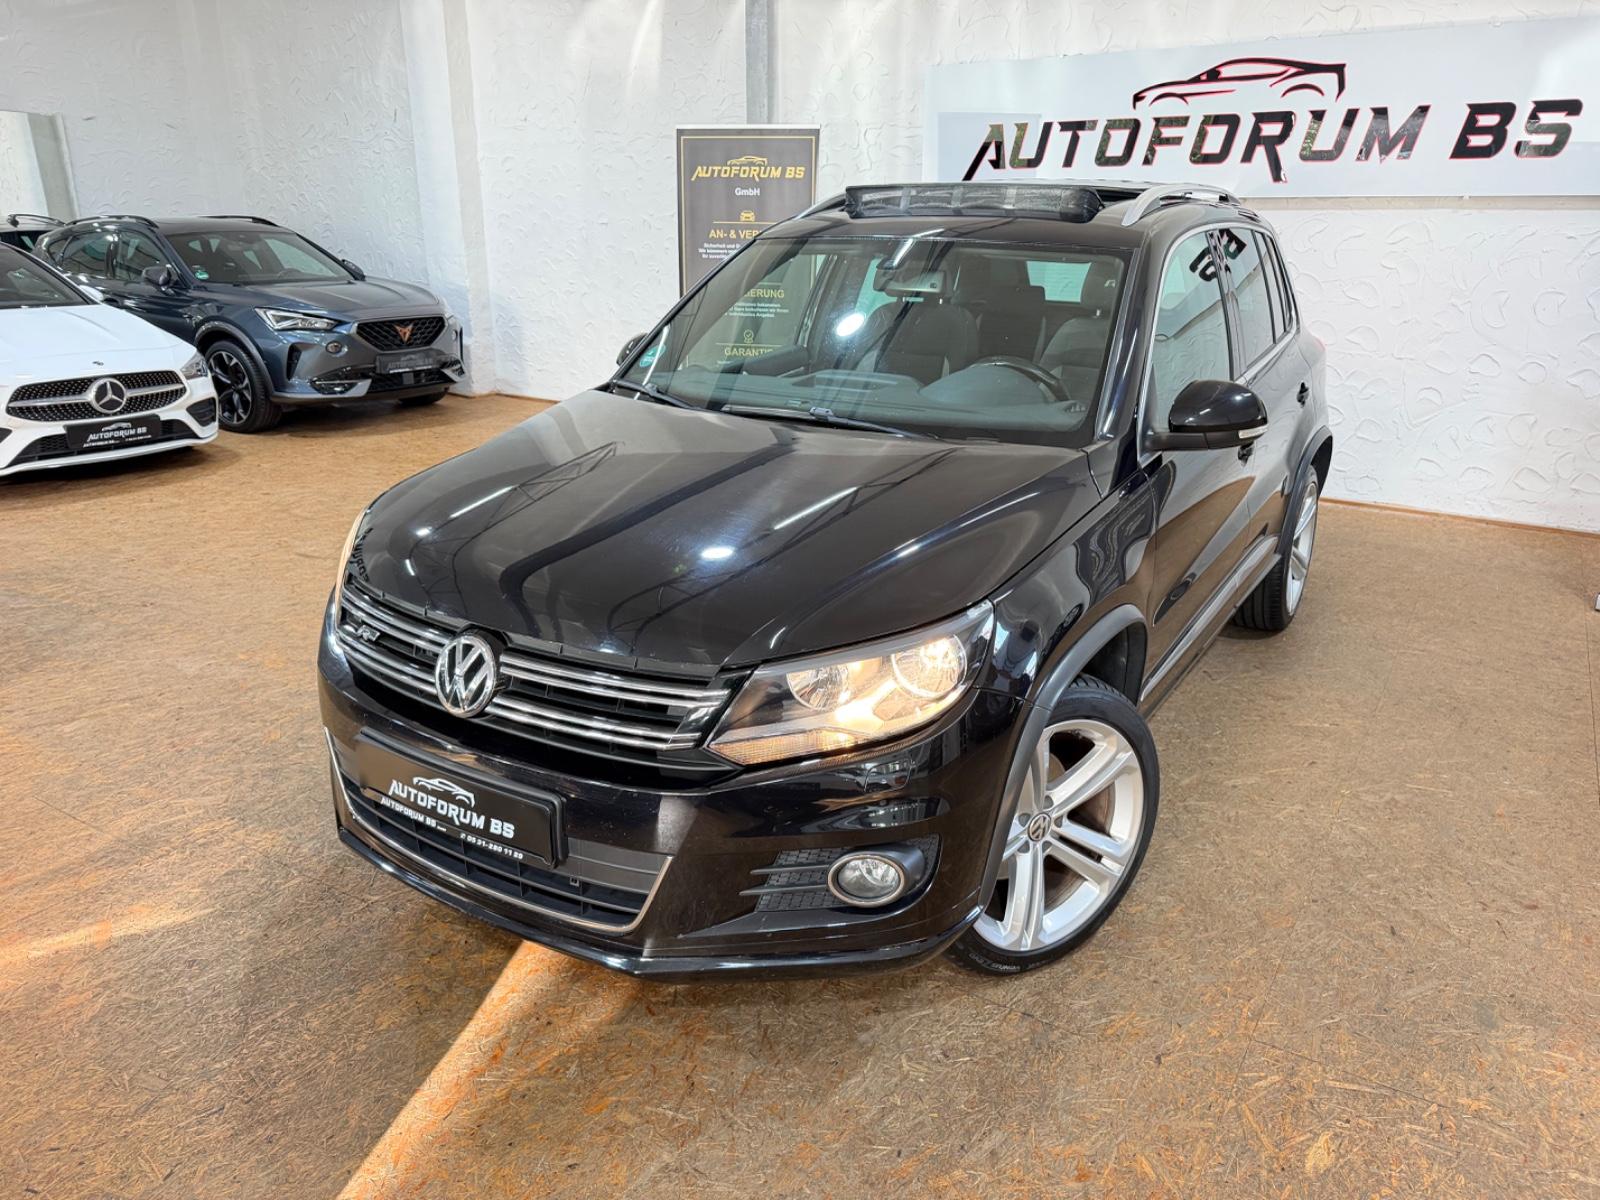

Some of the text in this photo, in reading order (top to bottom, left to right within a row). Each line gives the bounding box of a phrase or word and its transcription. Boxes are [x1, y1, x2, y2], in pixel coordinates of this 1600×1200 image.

[962, 98, 1584, 184] AUTOFORUM BS
[691, 165, 805, 181] AUTOFORUM BS
[734, 187, 760, 196] GmbH
[709, 229, 763, 240] AN- & VER
[86, 428, 136, 442] AUTOFORUM
[380, 796, 425, 822] AUTOFORUM
[388, 779, 515, 839] AUTOFORUM BS
